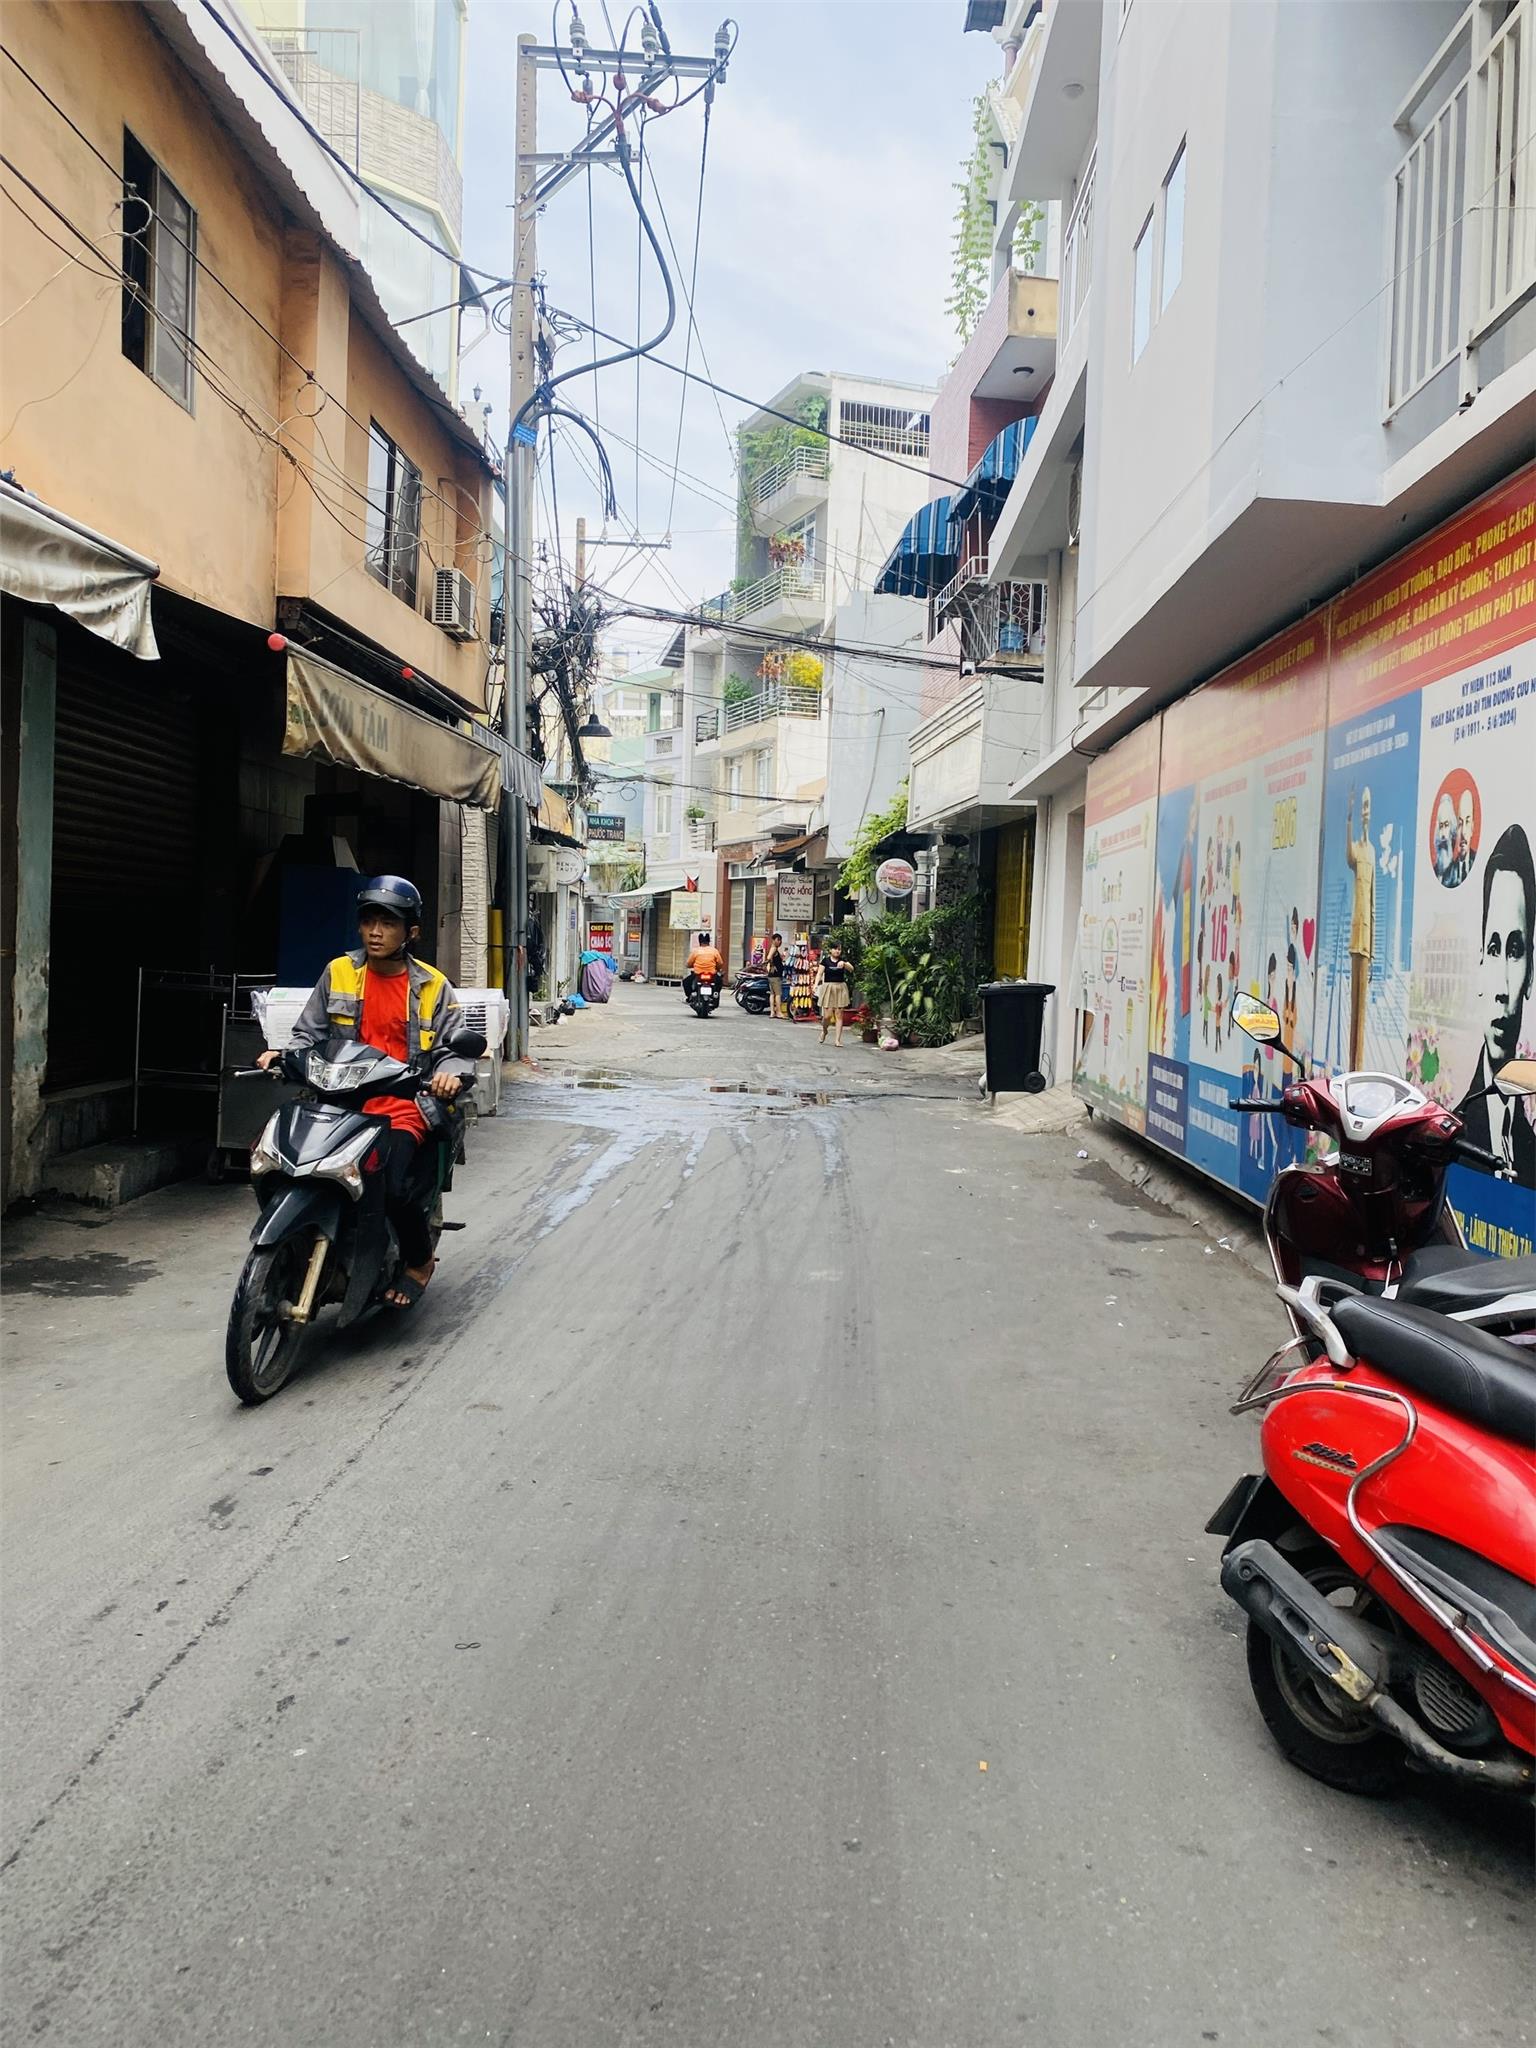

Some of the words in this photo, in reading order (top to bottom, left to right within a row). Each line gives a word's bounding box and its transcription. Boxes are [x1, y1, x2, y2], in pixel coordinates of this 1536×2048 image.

[1474, 518, 1506, 558] PHONG
[1508, 501, 1534, 538] CÁCH
[1493, 553, 1511, 583] THU
[1512, 541, 1532, 573] HÚT
[1486, 671, 1496, 688] 113
[361, 698, 389, 752] TẤM
[600, 818, 614, 826] KHOA
[606, 829, 624, 840] TRANG
[1211, 904, 1228, 962] 1/6
